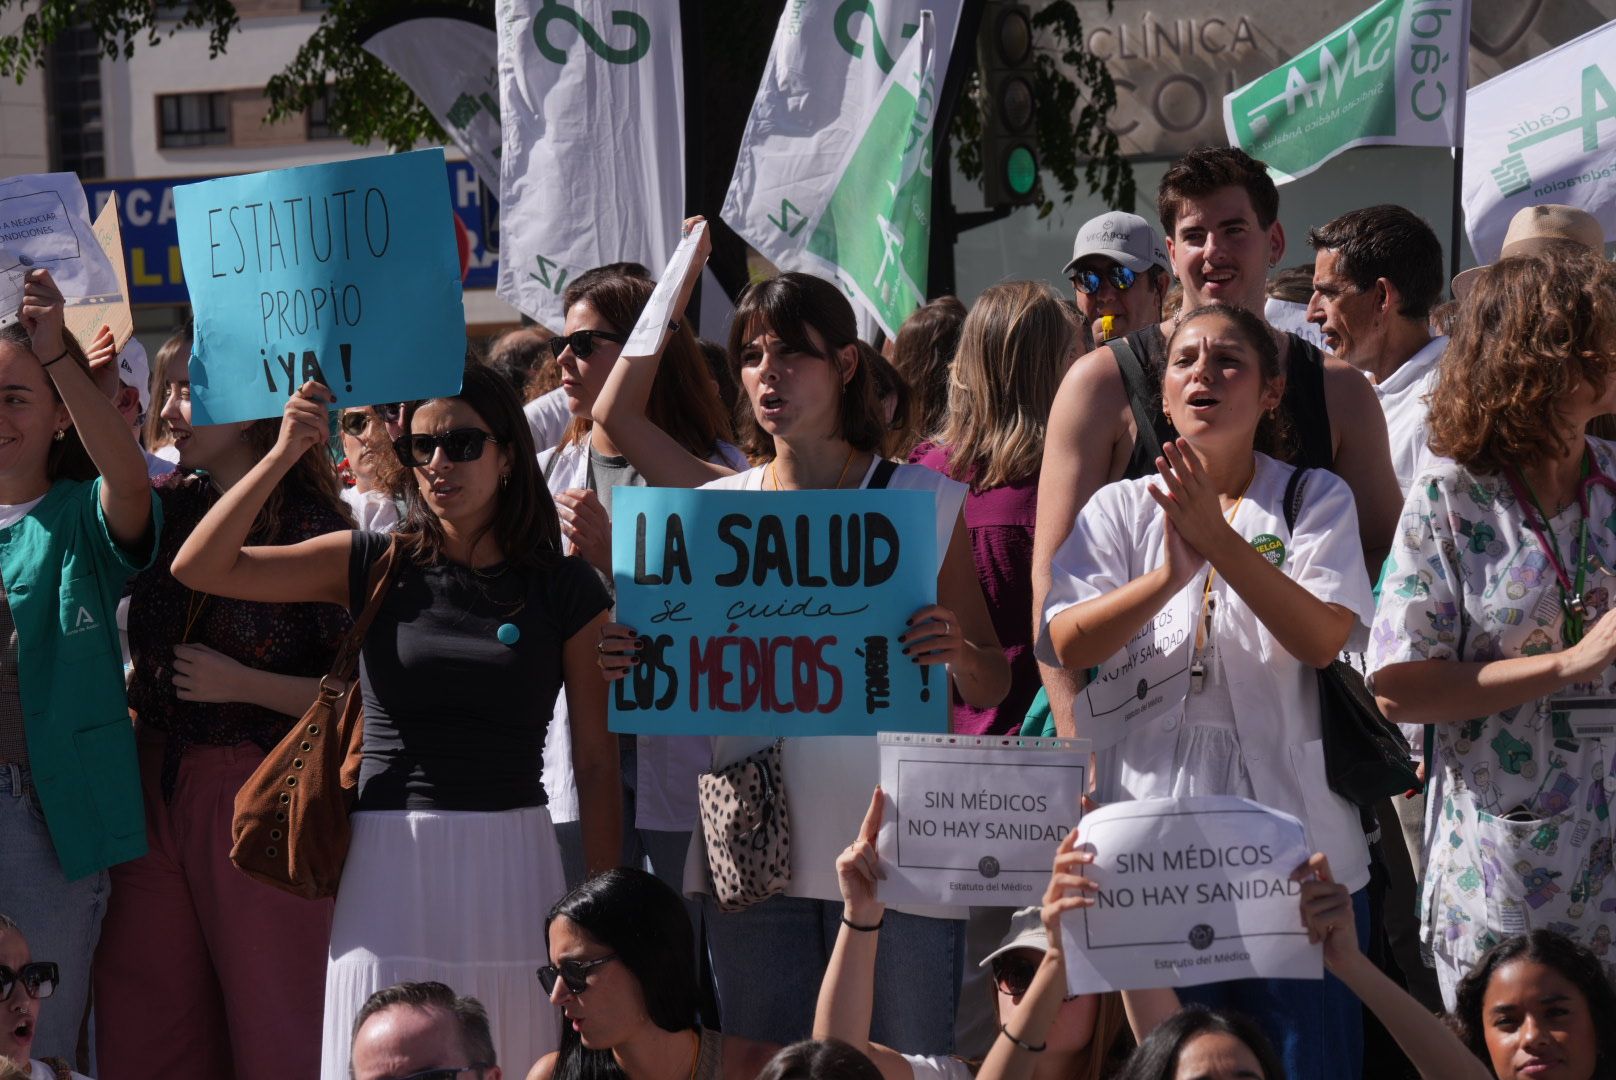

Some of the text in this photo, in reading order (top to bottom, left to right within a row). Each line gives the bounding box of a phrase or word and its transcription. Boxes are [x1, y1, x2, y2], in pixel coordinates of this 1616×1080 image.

[1089, 11, 1258, 61] CLÍNICA
[11, 212, 56, 228] NEGOCIAR
[208, 187, 390, 279] ESTATUTO
[634, 511, 900, 588] LA SALUD
[726, 596, 869, 621] cuida
[1139, 629, 1184, 665] SANIDAD
[689, 623, 843, 714] MÉDICOS
[924, 788, 1047, 813] SIN MÉDICOS
[908, 819, 1071, 842] NO HAY SANIDAD
[1115, 843, 1274, 875] SIN MÉDICOS
[949, 881, 1033, 893] Estatuto del Médico
[1098, 877, 1303, 909] NO HAY SANIDAD
[1154, 951, 1250, 970] Estatuto del Médico
